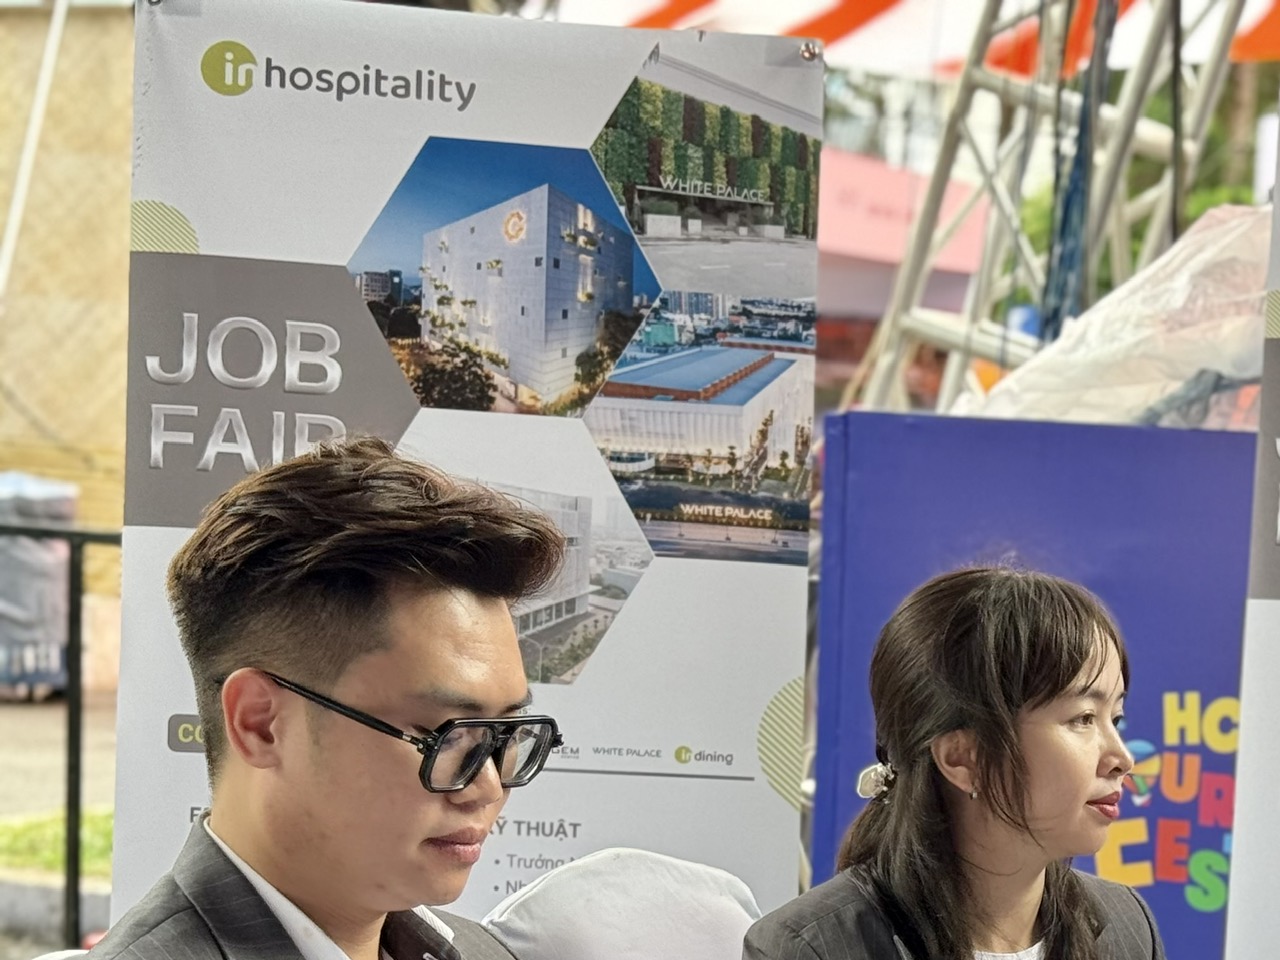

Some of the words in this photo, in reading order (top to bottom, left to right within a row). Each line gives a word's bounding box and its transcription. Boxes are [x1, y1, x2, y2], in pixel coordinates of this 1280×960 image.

[265, 58, 476, 111] hospitality
[659, 175, 712, 197] WHITE
[716, 184, 765, 200] PALACE
[146, 312, 342, 394] JOB
[680, 504, 723, 516] WHITE
[725, 506, 773, 520] PALACE
[592, 747, 624, 756] WHITE
[626, 749, 662, 757] PALACE
[694, 750, 733, 765] dining
[513, 819, 582, 841] THUẬT
